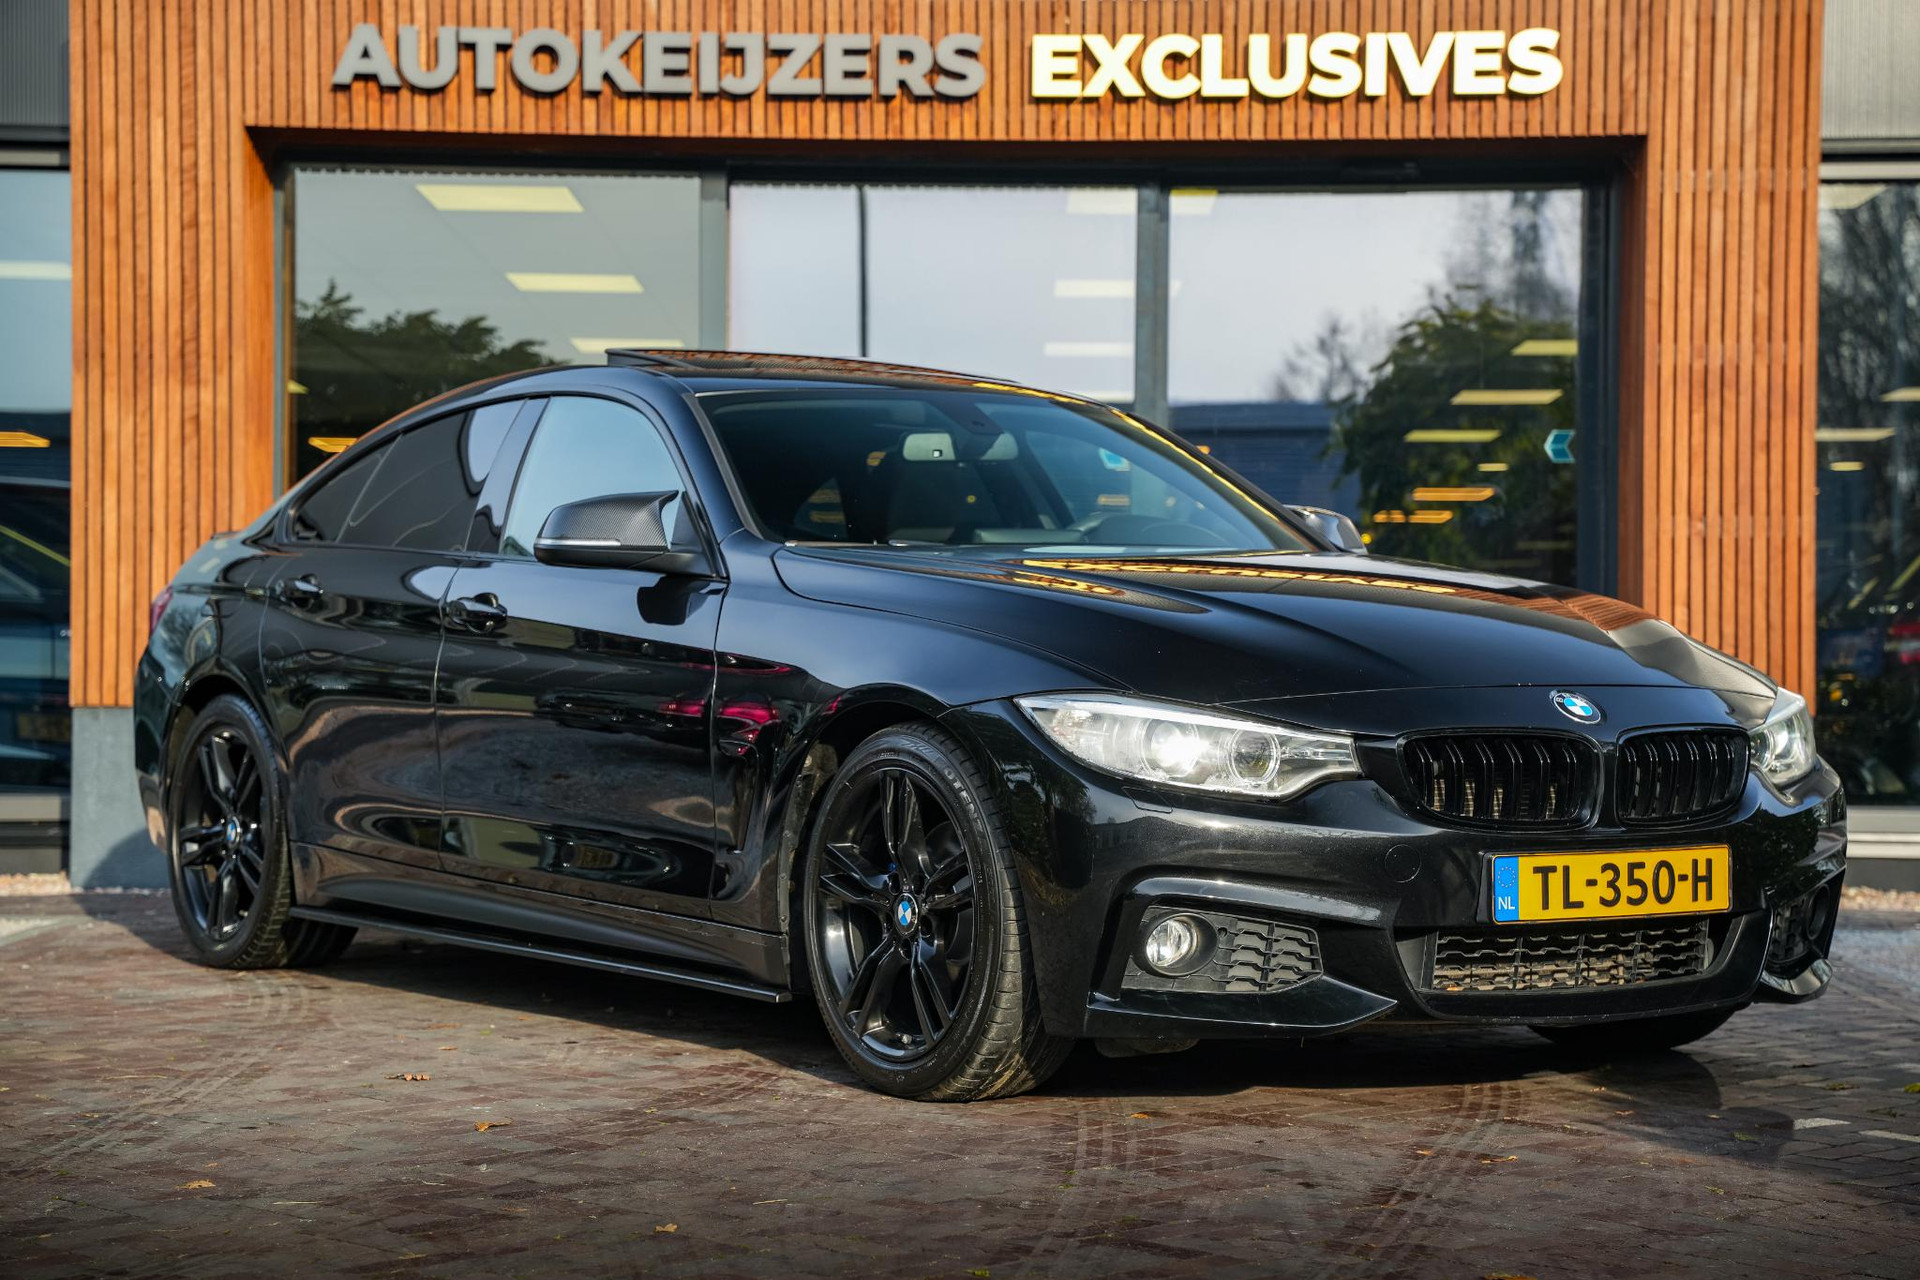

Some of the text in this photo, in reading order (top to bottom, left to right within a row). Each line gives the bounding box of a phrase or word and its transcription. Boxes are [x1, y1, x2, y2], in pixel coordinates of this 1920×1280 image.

[332, 23, 1564, 100] AUTOKEIJZERS EXCLUSIVES
[1498, 895, 1516, 910] NL
[1532, 857, 1713, 911] TL-350-H
